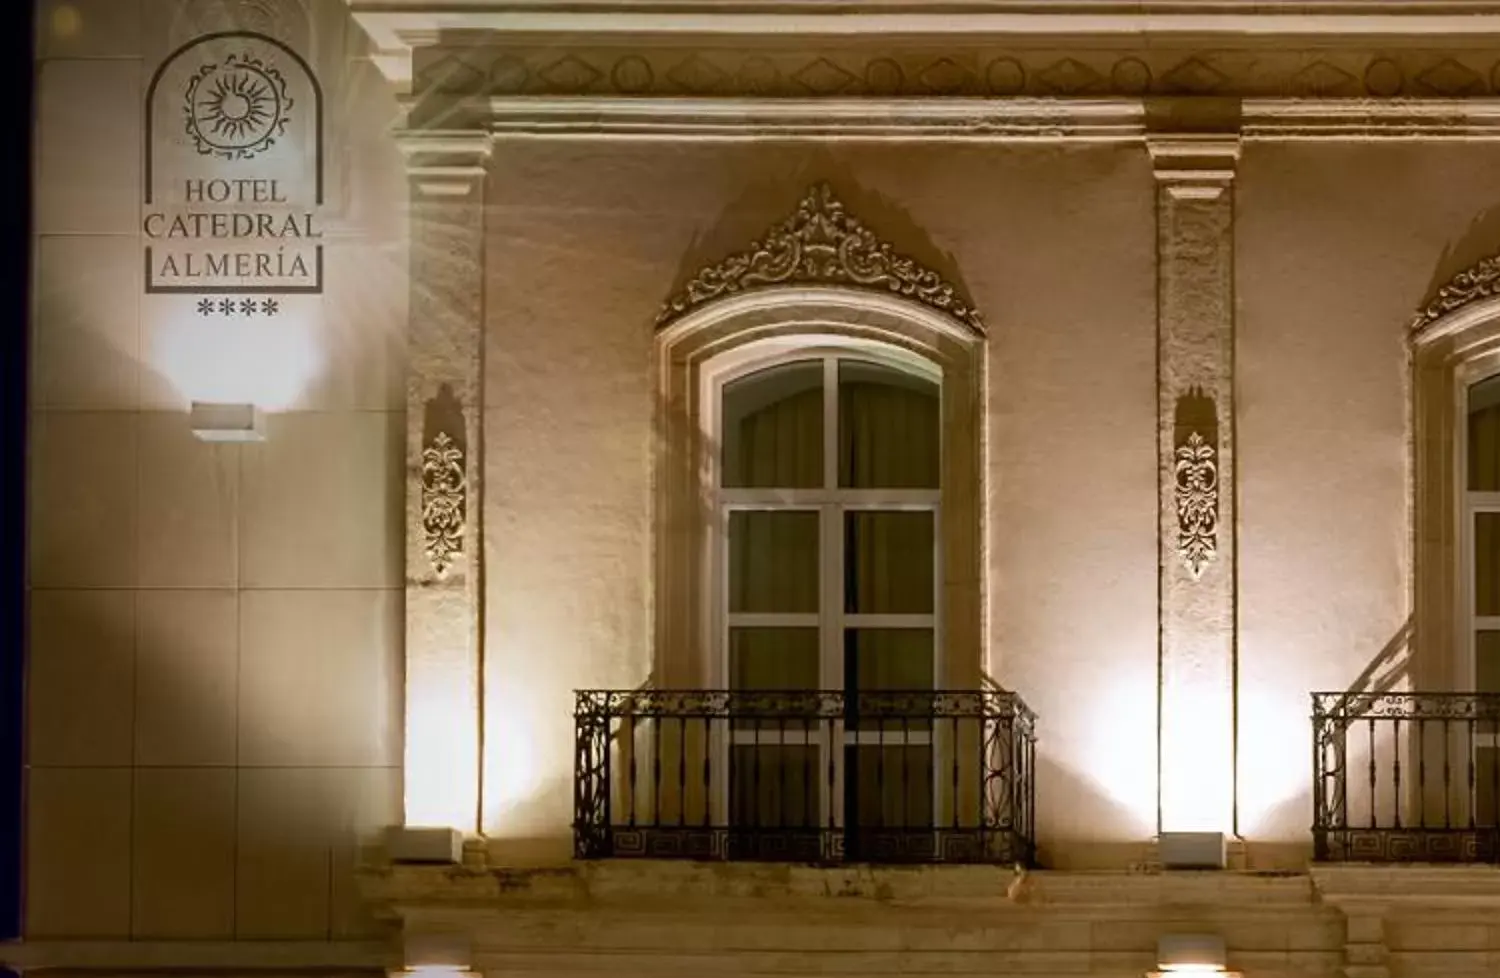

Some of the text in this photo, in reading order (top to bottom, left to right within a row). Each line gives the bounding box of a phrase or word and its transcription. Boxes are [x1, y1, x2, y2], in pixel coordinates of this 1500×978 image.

[185, 180, 287, 203] HOTEL
[143, 213, 323, 239] CATEDRAL
[160, 246, 309, 278] ALMERÍA
